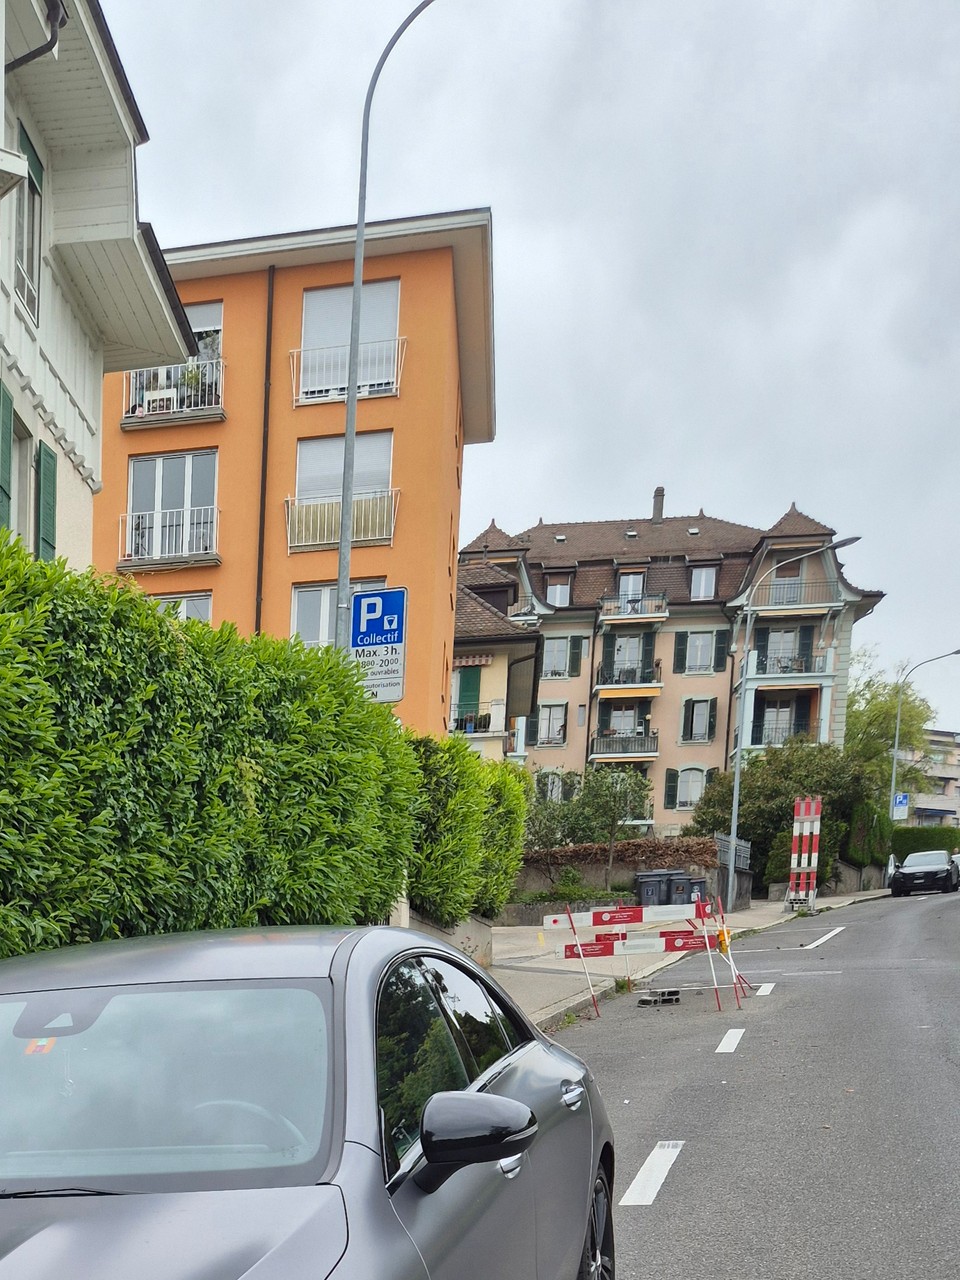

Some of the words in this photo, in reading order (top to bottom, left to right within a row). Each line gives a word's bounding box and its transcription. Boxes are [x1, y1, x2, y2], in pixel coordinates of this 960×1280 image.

[360, 597, 382, 632] P
[357, 632, 398, 645] Collectif
[355, 648, 380, 659] Max.
[370, 668, 399, 676] ouvrables
[365, 681, 400, 689] autorisation
[896, 795, 903, 804] P
